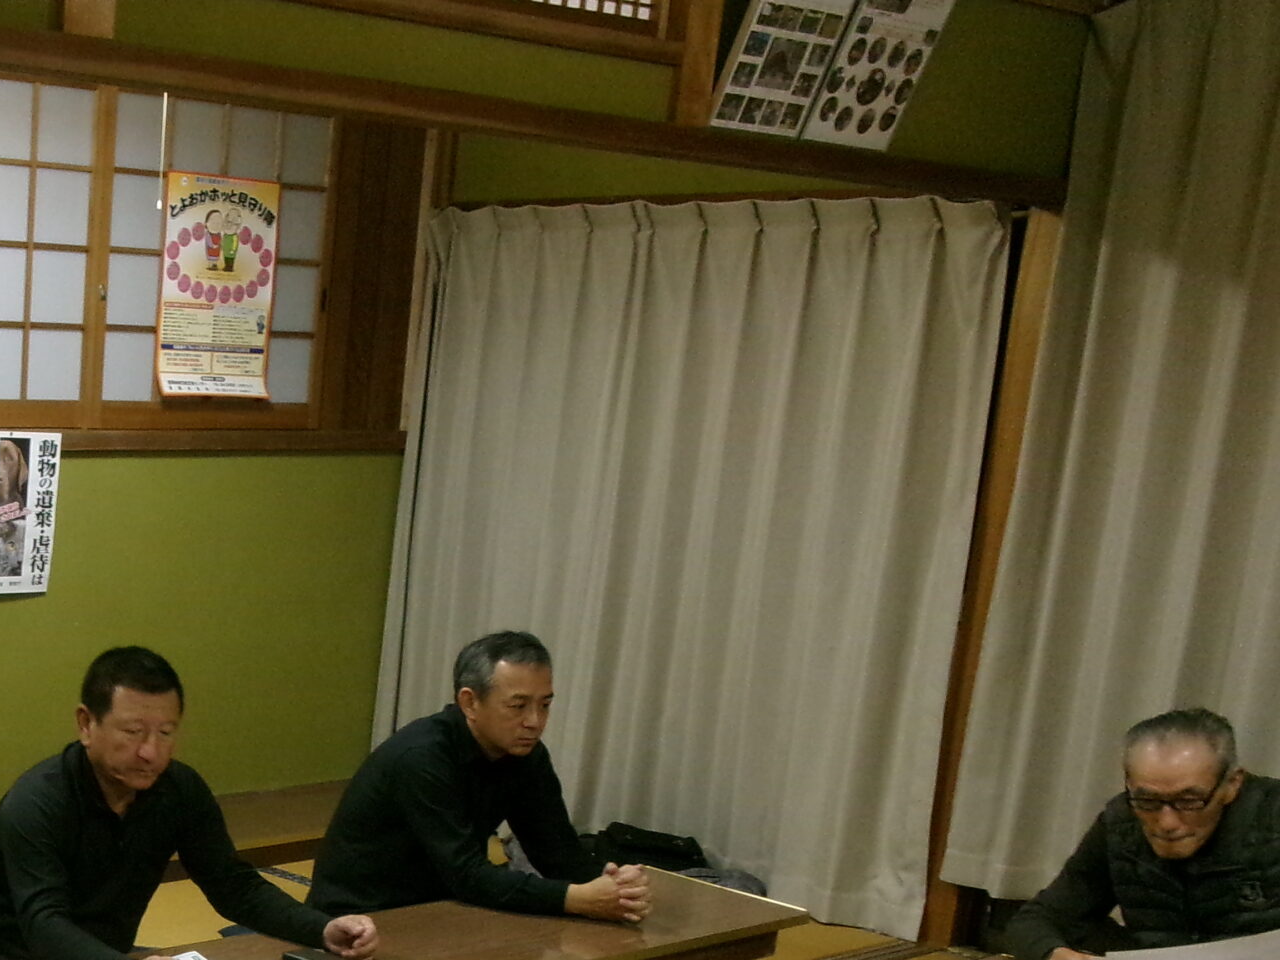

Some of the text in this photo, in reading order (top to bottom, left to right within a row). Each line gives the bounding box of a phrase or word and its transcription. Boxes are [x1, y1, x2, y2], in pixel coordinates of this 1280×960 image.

[30, 439, 59, 586] 動物の遺棄・虐待は
